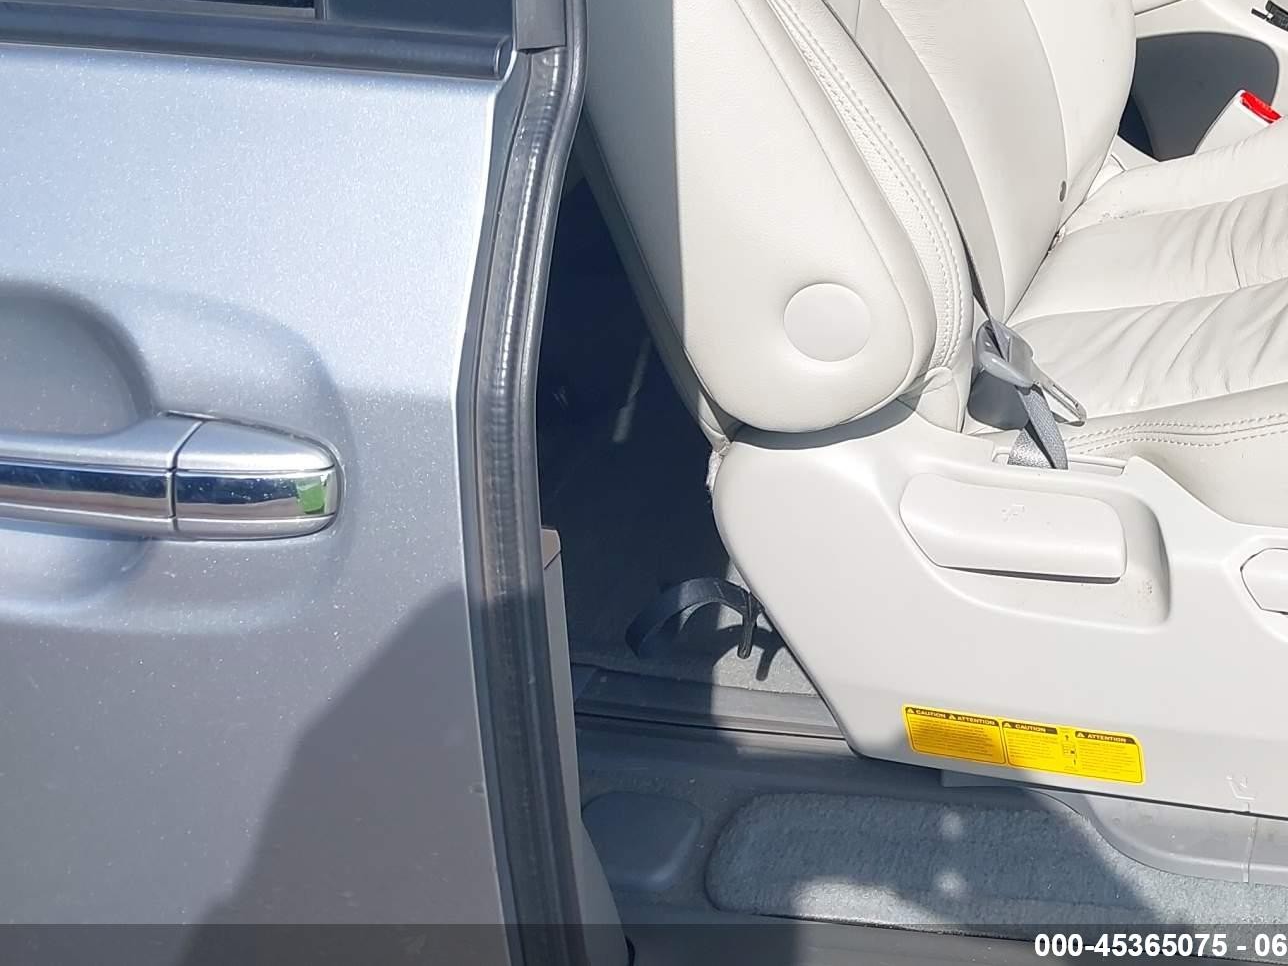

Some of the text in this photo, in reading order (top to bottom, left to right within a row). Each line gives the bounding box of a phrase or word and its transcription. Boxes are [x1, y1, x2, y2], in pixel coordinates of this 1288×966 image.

[916, 709, 996, 726] CAUTION ATTENTION
[1015, 723, 1046, 733] CAUTION
[1087, 733, 1127, 743] ATTENTION
